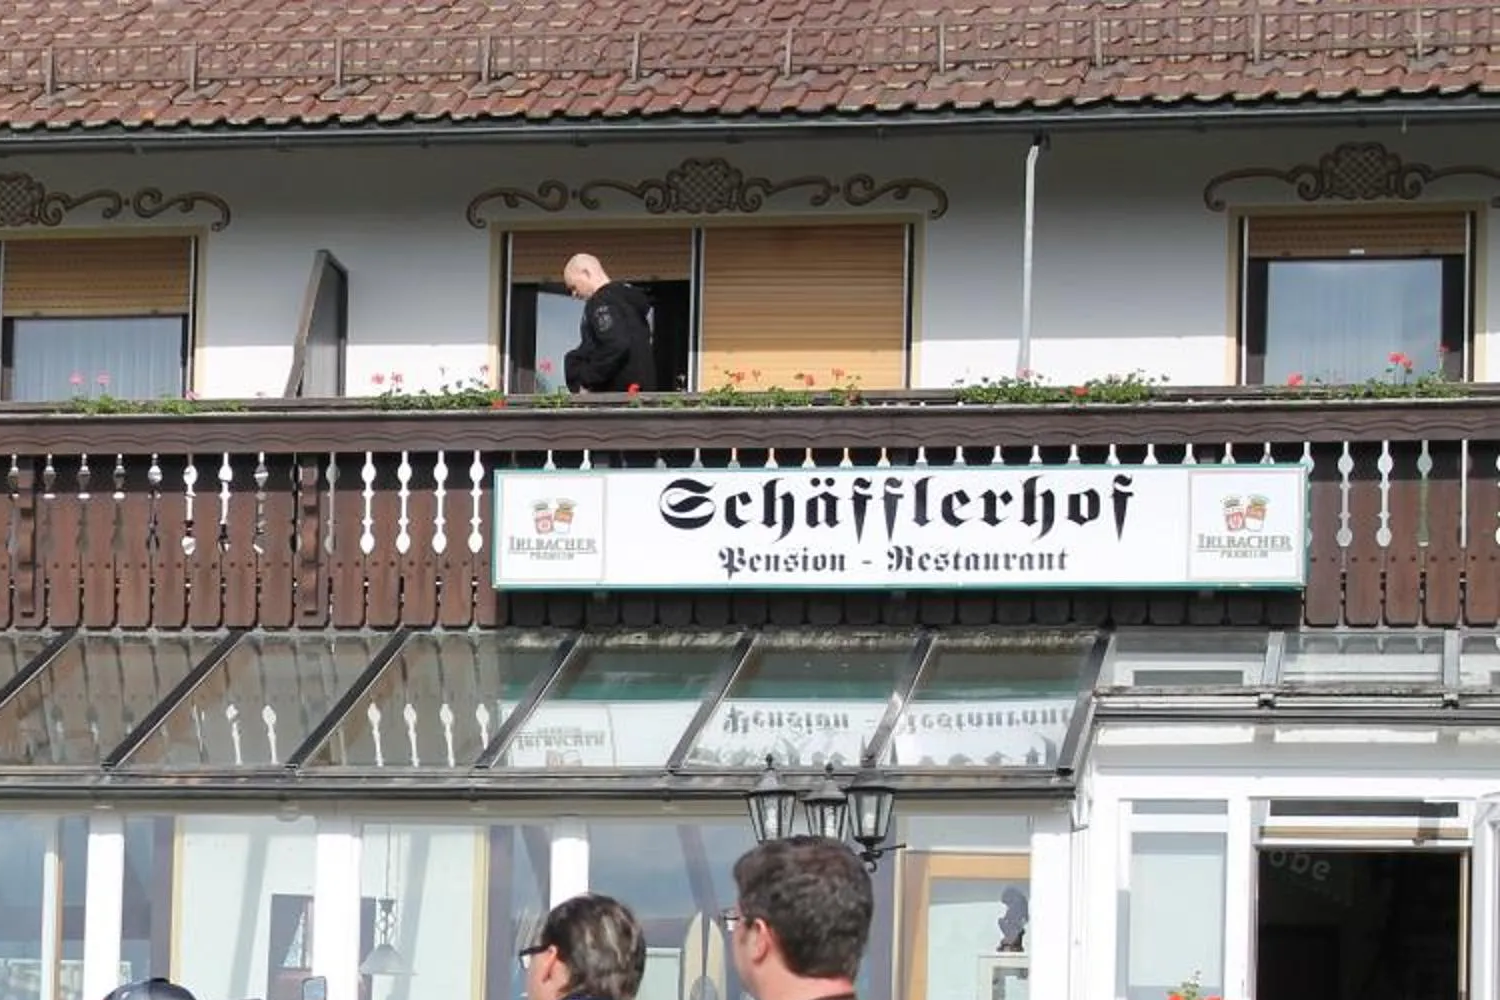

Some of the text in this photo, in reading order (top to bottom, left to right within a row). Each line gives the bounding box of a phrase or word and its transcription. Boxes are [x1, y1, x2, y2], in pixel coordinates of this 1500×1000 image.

[658, 473, 1135, 545] Schäfflerhof
[717, 547, 847, 580] Pension
[887, 545, 1070, 573] Restaurant
